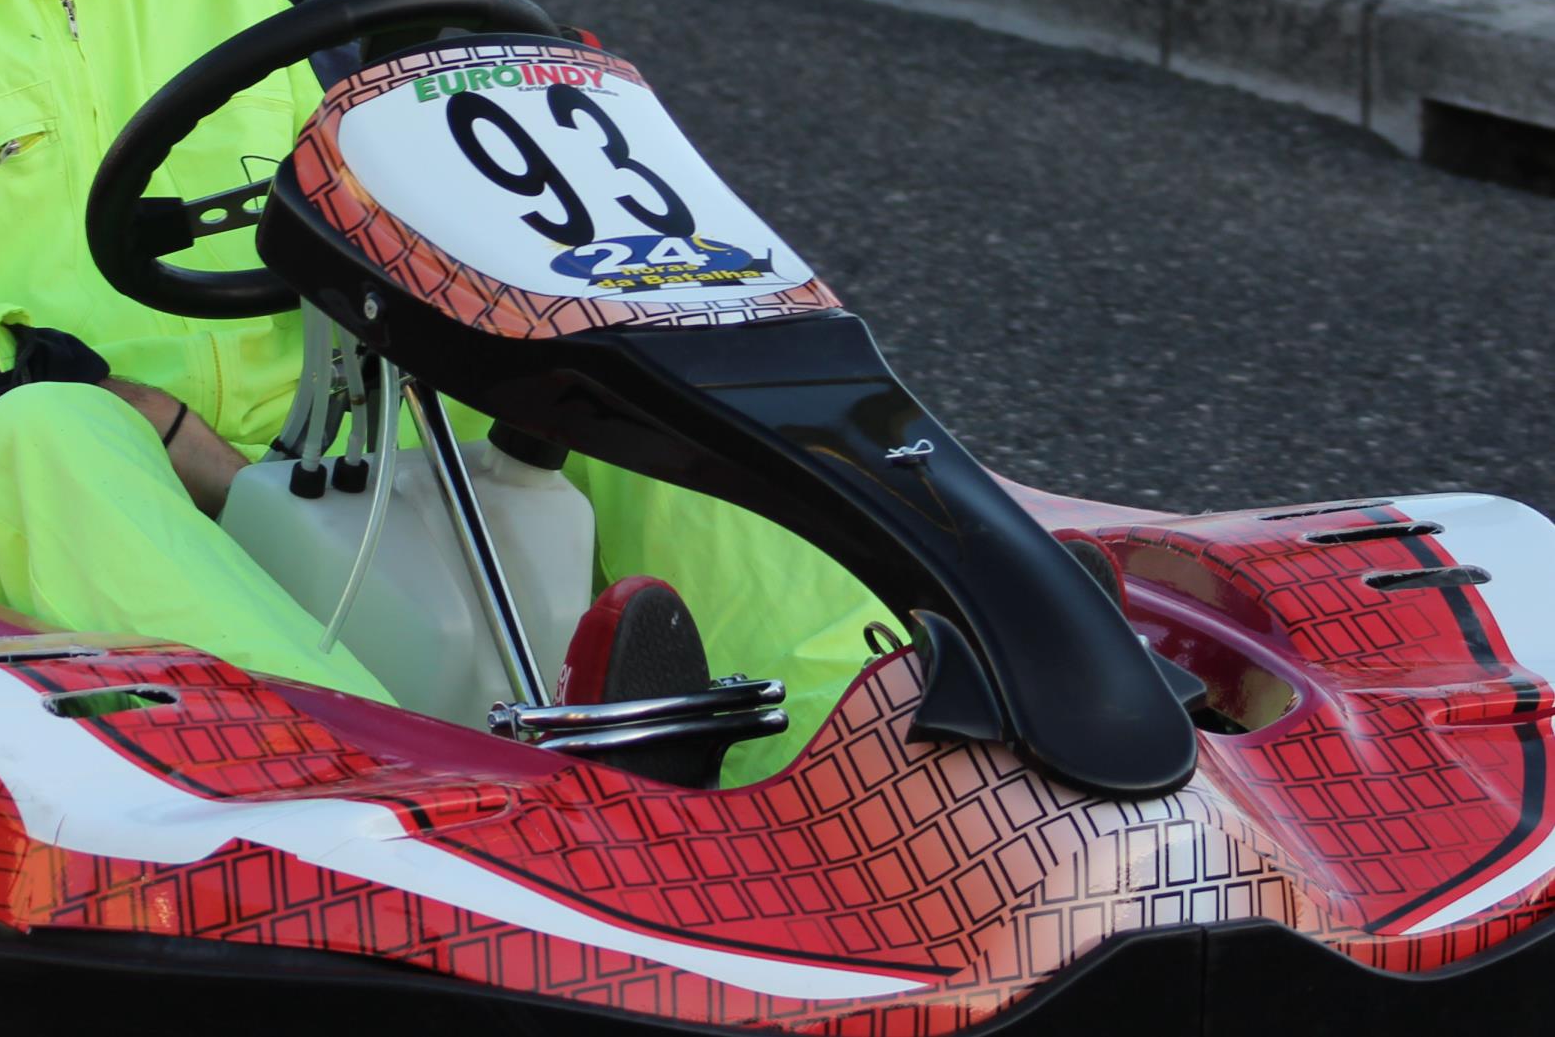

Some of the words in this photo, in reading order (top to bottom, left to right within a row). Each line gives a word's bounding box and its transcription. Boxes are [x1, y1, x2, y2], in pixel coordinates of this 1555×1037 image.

[413, 64, 605, 103] EUROINDY
[446, 82, 696, 248] 93
[573, 236, 711, 276] 24
[620, 262, 699, 277] horas
[596, 276, 637, 289] da
[642, 268, 763, 287] Batalha
